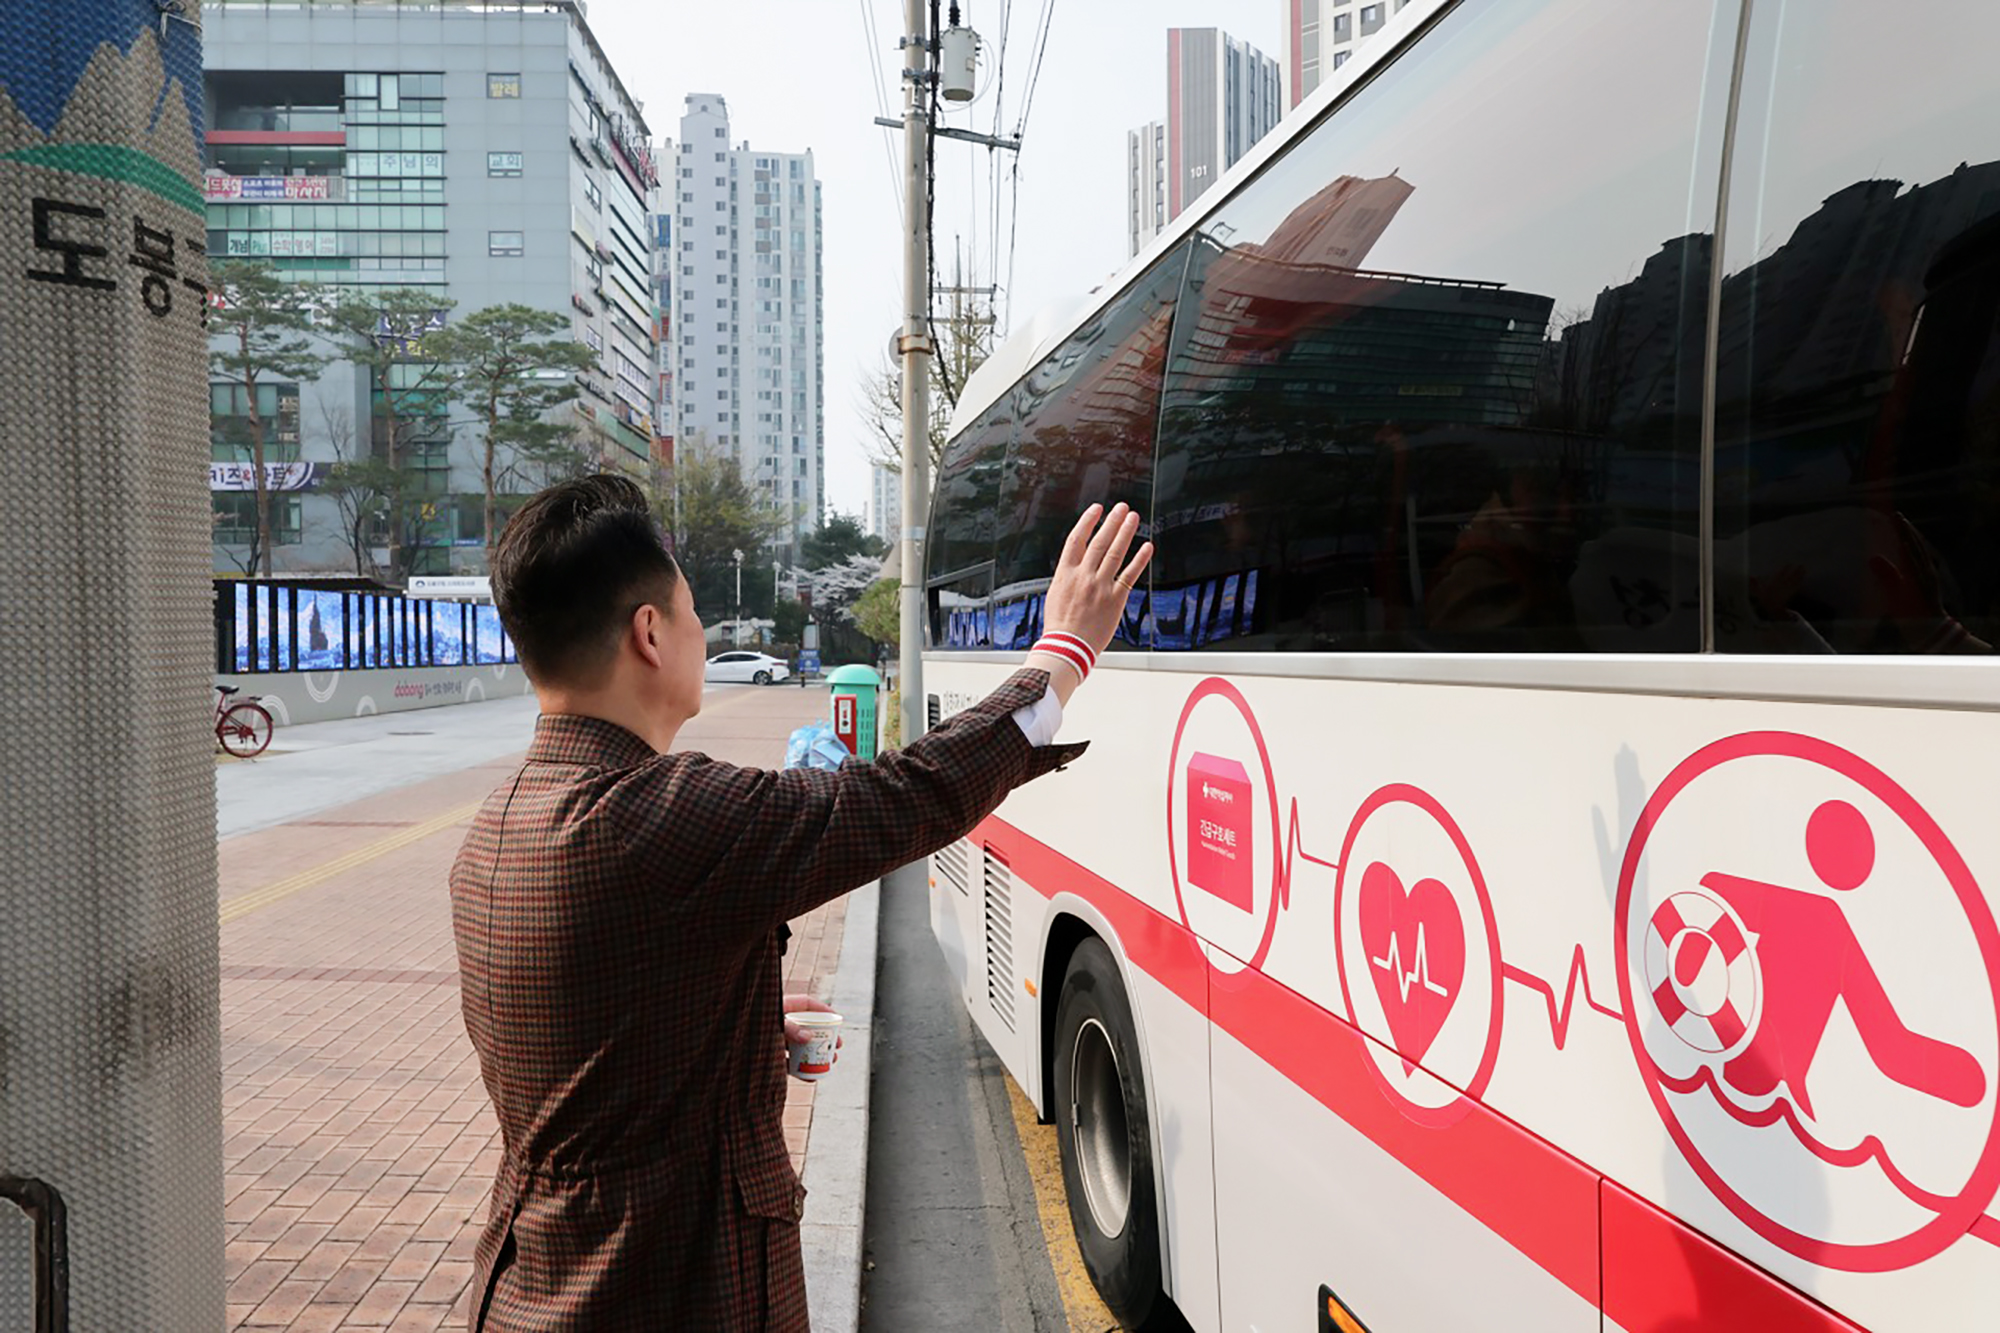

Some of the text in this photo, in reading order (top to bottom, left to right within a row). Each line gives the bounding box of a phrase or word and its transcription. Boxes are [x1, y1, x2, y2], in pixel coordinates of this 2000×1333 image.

[384, 154, 438, 169] 주님의
[491, 154, 519, 168] 교회
[1190, 165, 1207, 179] 101
[285, 187, 327, 199] 마사지
[229, 239, 249, 254] 개념
[273, 240, 291, 254] 수학
[295, 239, 315, 254] 영어
[394, 679, 423, 700] dobong
[1200, 818, 1237, 847] 긴급구호세트
